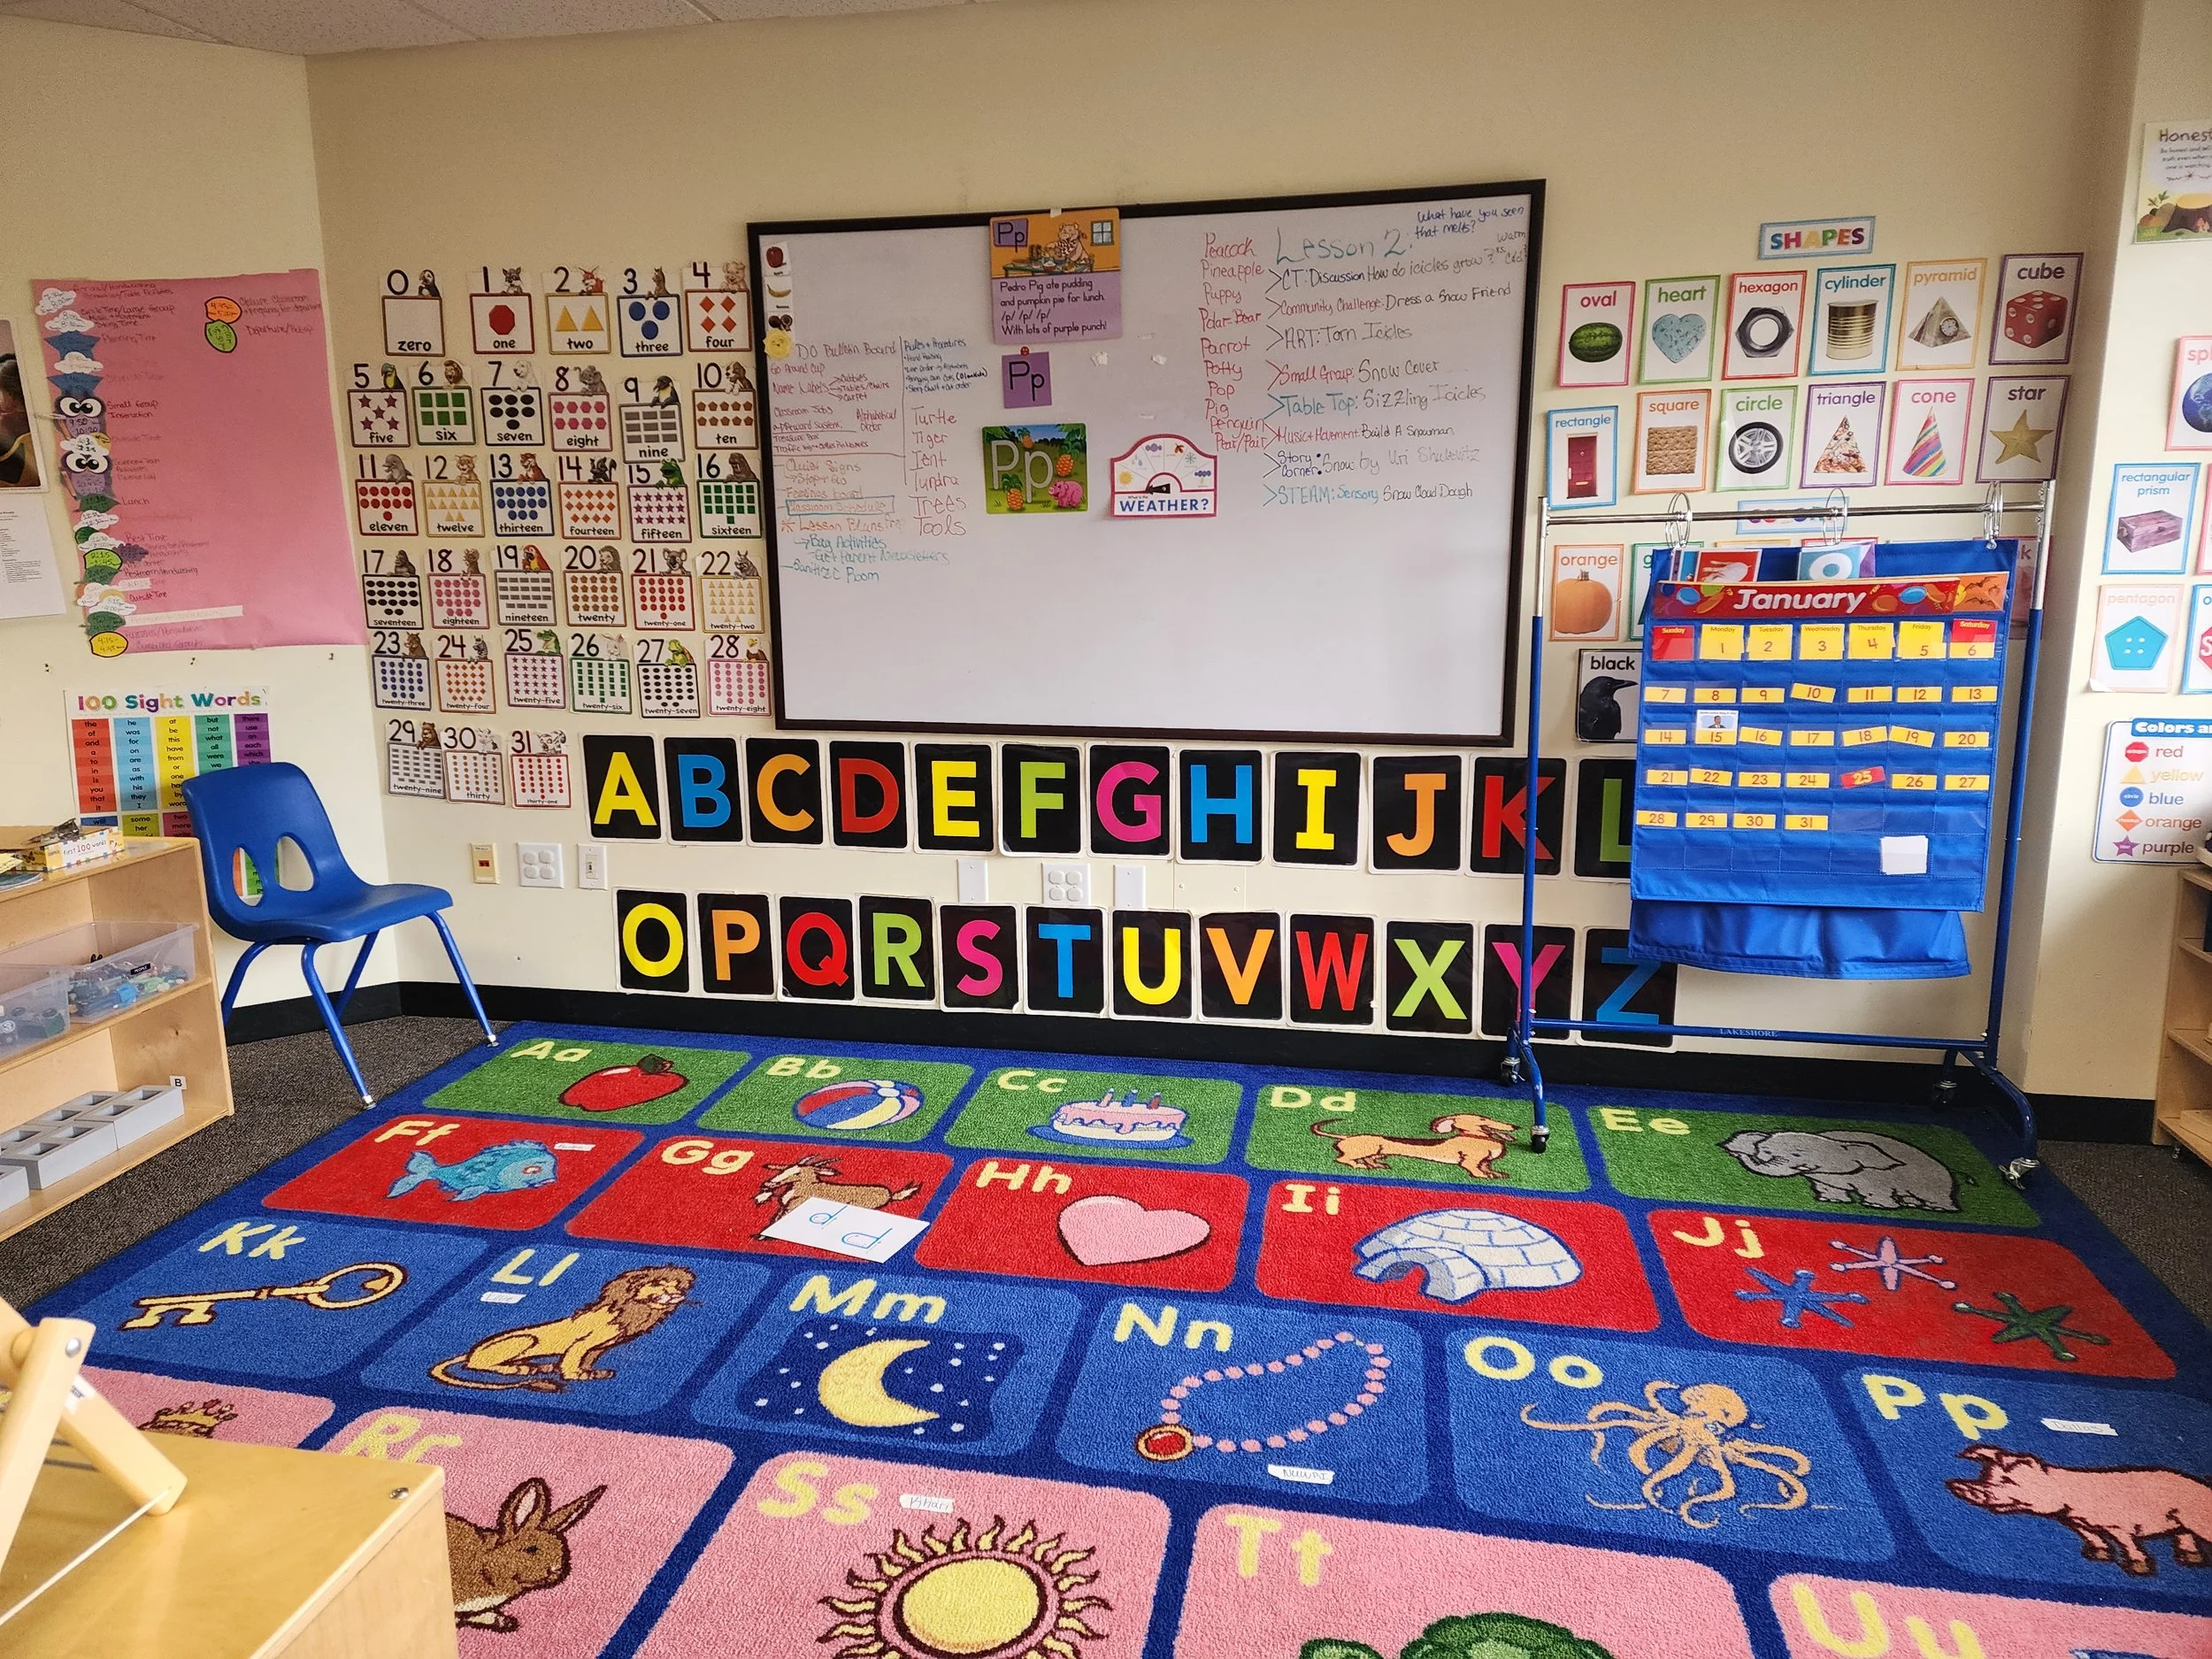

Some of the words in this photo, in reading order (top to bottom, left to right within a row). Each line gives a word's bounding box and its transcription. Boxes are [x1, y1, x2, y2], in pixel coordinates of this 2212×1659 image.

[1450, 207, 1471, 218] have
[1479, 208, 1497, 220] you
[1503, 205, 1525, 216] seen
[1205, 233, 1257, 257] Peacock
[1276, 227, 1374, 264] Lesson
[1770, 227, 1865, 250] SHAPES
[693, 262, 710, 288] 4
[1202, 259, 1264, 281] Pineapple
[1914, 269, 1978, 285] pyramid
[2017, 263, 2065, 280] cube
[388, 269, 409, 295] 0
[483, 266, 489, 292] 1
[554, 266, 570, 292] 2
[623, 268, 637, 294] 3
[1000, 281, 1025, 292] Pedro
[1028, 280, 1043, 293] Pig
[1046, 280, 1059, 289] ate
[1062, 278, 1093, 292] pudding
[1825, 274, 1886, 292] cylinder
[1204, 282, 1241, 303] Puppy
[1658, 286, 1707, 302] heart
[1739, 281, 1798, 295] hexagon
[1001, 297, 1015, 306] and
[1018, 296, 1050, 308] pumpkin
[1053, 294, 1064, 306] pie
[1067, 293, 1079, 303] for
[1386, 294, 1422, 311] Dress
[1580, 290, 1617, 307] oval
[1002, 325, 1024, 335] With
[1025, 324, 1041, 334] lots
[1042, 322, 1052, 333] of
[1054, 324, 1079, 336] purple
[1081, 321, 1107, 335] punch!
[398, 340, 432, 352] zero
[493, 339, 515, 349] one
[567, 338, 593, 349] two
[635, 342, 669, 352] three
[706, 336, 734, 349] four
[354, 363, 370, 388] 5
[418, 361, 434, 386] 6
[488, 361, 503, 386] 7
[555, 366, 570, 391] 8
[697, 363, 722, 388] 10
[1359, 359, 1400, 382] Snow
[1009, 361, 1045, 401] Pp
[1209, 381, 1235, 397] Pop
[625, 377, 640, 402] 9
[1911, 390, 1956, 403] cone
[2008, 386, 2046, 401] star
[1736, 396, 1783, 411] circle
[1816, 391, 1876, 407] triangle
[1649, 401, 1699, 414] square
[910, 406, 957, 426] Turtle
[1555, 415, 1610, 427] rectangle
[369, 432, 393, 443] five
[435, 428, 457, 441] six
[497, 432, 533, 441] seven
[715, 434, 736, 444] ten
[1406, 426, 1455, 436] Snowman
[566, 434, 599, 448] eight
[639, 447, 668, 458] nine
[991, 440, 1053, 503] Pp
[2121, 472, 2191, 483] rectangular
[2138, 485, 2170, 497] prism
[909, 495, 966, 516] Trees
[1120, 499, 1210, 511] WEATHER?
[913, 515, 966, 536] Tools
[1561, 553, 1617, 569] orange
[1733, 588, 1865, 613] January
[2108, 593, 2175, 606] pentagon
[1763, 641, 1772, 653] 2
[1818, 641, 1826, 652] 3
[1920, 645, 1929, 657] 5
[1968, 645, 1977, 657] 6
[1590, 656, 1635, 671] black
[78, 695, 117, 710] 100
[126, 694, 183, 713] Sight
[191, 691, 261, 707] Words
[1711, 690, 1719, 701] 8
[1913, 689, 1926, 701] 12
[2136, 722, 2194, 734] Colors
[1958, 733, 1976, 745] 20
[2155, 745, 2183, 758] red
[1752, 773, 1768, 785] 23
[2151, 768, 2203, 783] yellow
[594, 752, 657, 826] A
[679, 755, 731, 828] B
[757, 754, 814, 832] C
[839, 758, 899, 833] D
[933, 761, 979, 837] E
[1020, 762, 1065, 839] F
[1097, 761, 1161, 842] G
[1191, 764, 1252, 844] H
[1296, 769, 1336, 849] I
[1387, 773, 1446, 856] J
[1483, 775, 1555, 860] K
[2148, 793, 2184, 805] blue
[1801, 816, 1813, 827] 31
[2146, 816, 2201, 831] orange
[77, 842, 91, 853] 100
[92, 840, 106, 849] words
[2143, 841, 2194, 855] purple
[133, 964, 149, 973] PEOPLE
[623, 902, 684, 978] O
[712, 910, 760, 980] P
[787, 912, 849, 987] Q
[872, 913, 925, 987] R
[957, 920, 1002, 995] S
[1039, 924, 1091, 998] T
[1123, 927, 1181, 1005] U
[1206, 929, 1274, 1005] V
[1295, 932, 1368, 1011] W
[1393, 939, 1468, 1020] X
[1492, 942, 1566, 1022] Y
[1596, 948, 1660, 1025] Z
[1719, 1028, 1778, 1039] LAKESHORE
[511, 1041, 593, 1062] Aa
[765, 1056, 842, 1079] Bb
[174, 1078, 182, 1087] B
[996, 1068, 1067, 1093] Cc
[1270, 1087, 1356, 1111] Dd
[1600, 1108, 1690, 1135] Ee
[374, 1120, 459, 1146] Ff
[661, 1141, 755, 1175] Gg
[977, 1162, 1072, 1194] Hh
[1281, 1184, 1340, 1215] Ii
[199, 1222, 305, 1260] Kk
[1673, 1217, 1764, 1258] Jj
[790, 1274, 946, 1323] Mm
[1113, 1303, 1232, 1351] Nn
[1464, 1336, 1602, 1388] Oo
[1863, 1374, 2008, 1440] Pp
[757, 1462, 878, 1525] Ss
[1226, 1513, 1333, 1585] Tt
